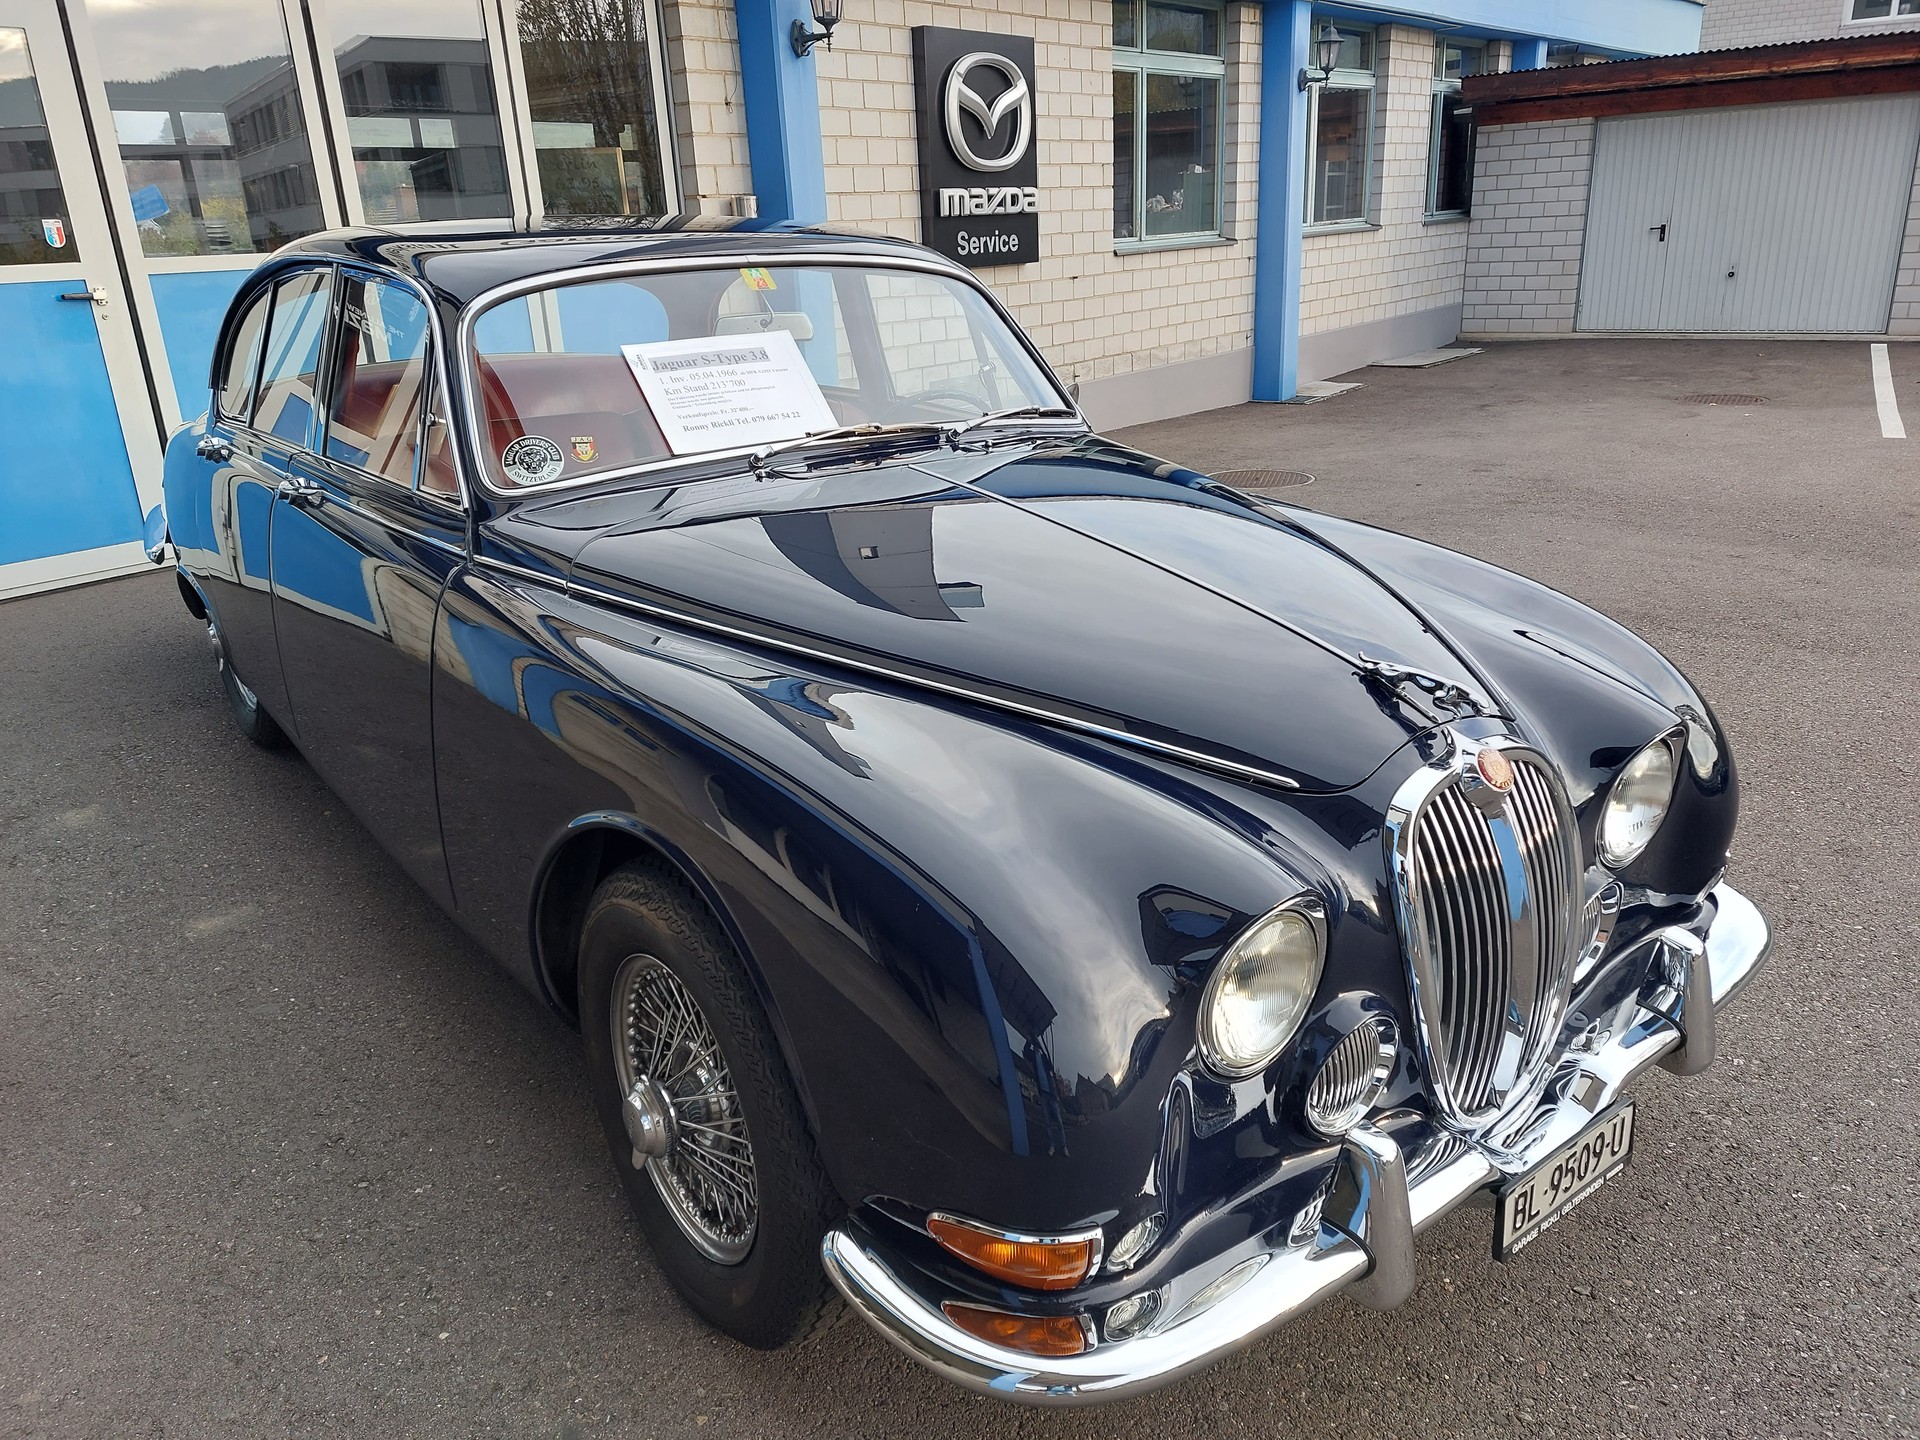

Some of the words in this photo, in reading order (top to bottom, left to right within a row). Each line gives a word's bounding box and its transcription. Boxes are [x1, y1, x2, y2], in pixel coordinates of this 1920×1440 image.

[957, 229, 1019, 256] Service
[652, 357, 698, 372] Jaguar
[701, 352, 748, 367] S-Type
[750, 350, 769, 360] 3.8
[689, 369, 737, 380] 05.04.1966
[683, 384, 709, 393] Stand
[710, 379, 746, 389] 213'700
[683, 423, 709, 433] Ronny
[711, 419, 734, 428] Rickli
[505, 444, 522, 464] JAGUAR
[548, 445, 560, 460] CLUB
[512, 467, 558, 483] SWITZERLAND
[1512, 1227, 1539, 1254] GARAGE
[1540, 1211, 1561, 1233] RICKLI
[1562, 1176, 1605, 1216] GELTERKINDEN
